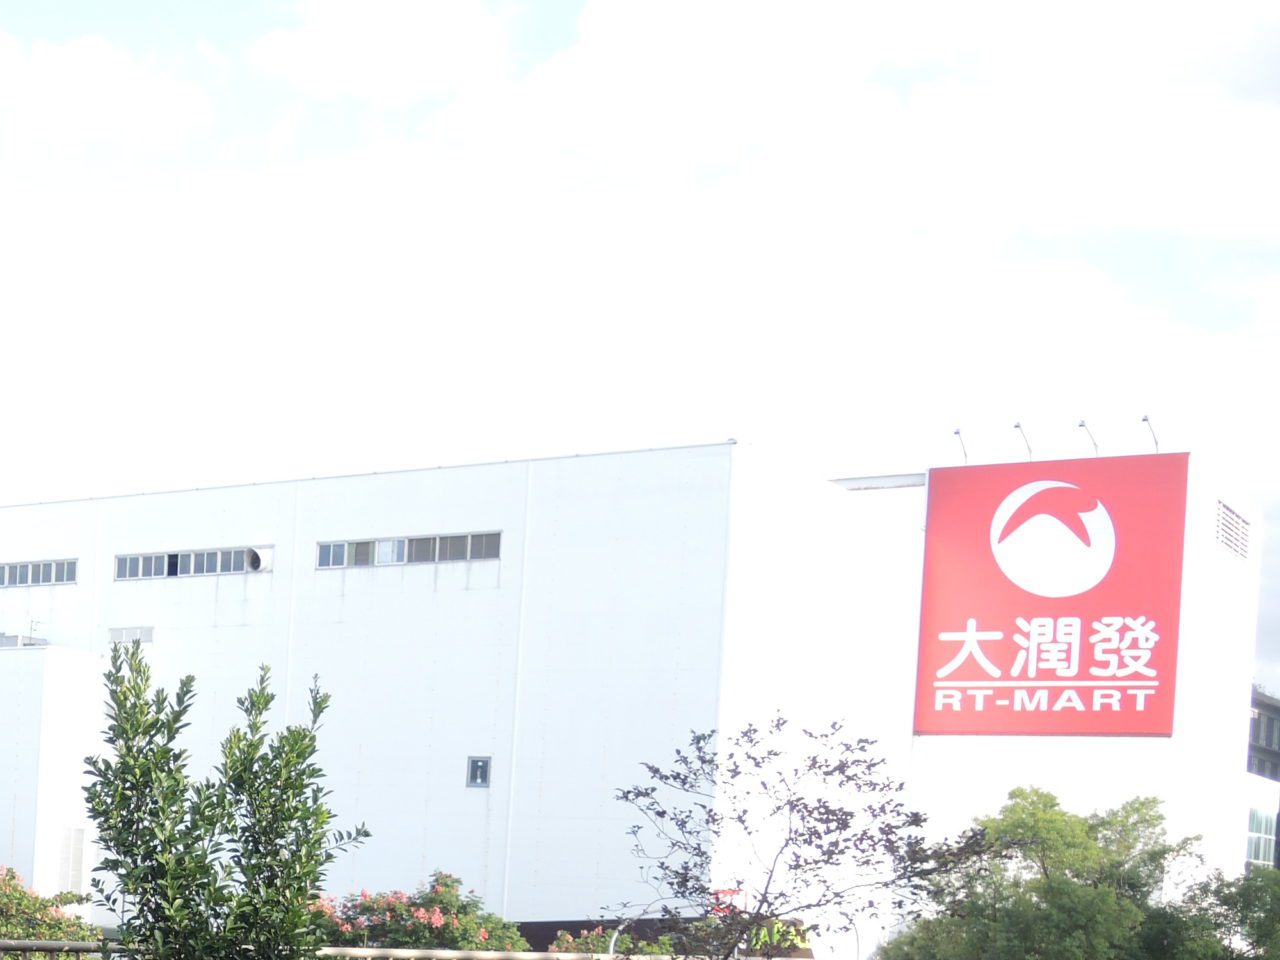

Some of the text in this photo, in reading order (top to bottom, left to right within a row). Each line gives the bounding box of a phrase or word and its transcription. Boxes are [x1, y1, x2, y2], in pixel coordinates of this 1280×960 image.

[935, 615, 1160, 678] 大潤發
[933, 689, 1156, 711] RT-MART
